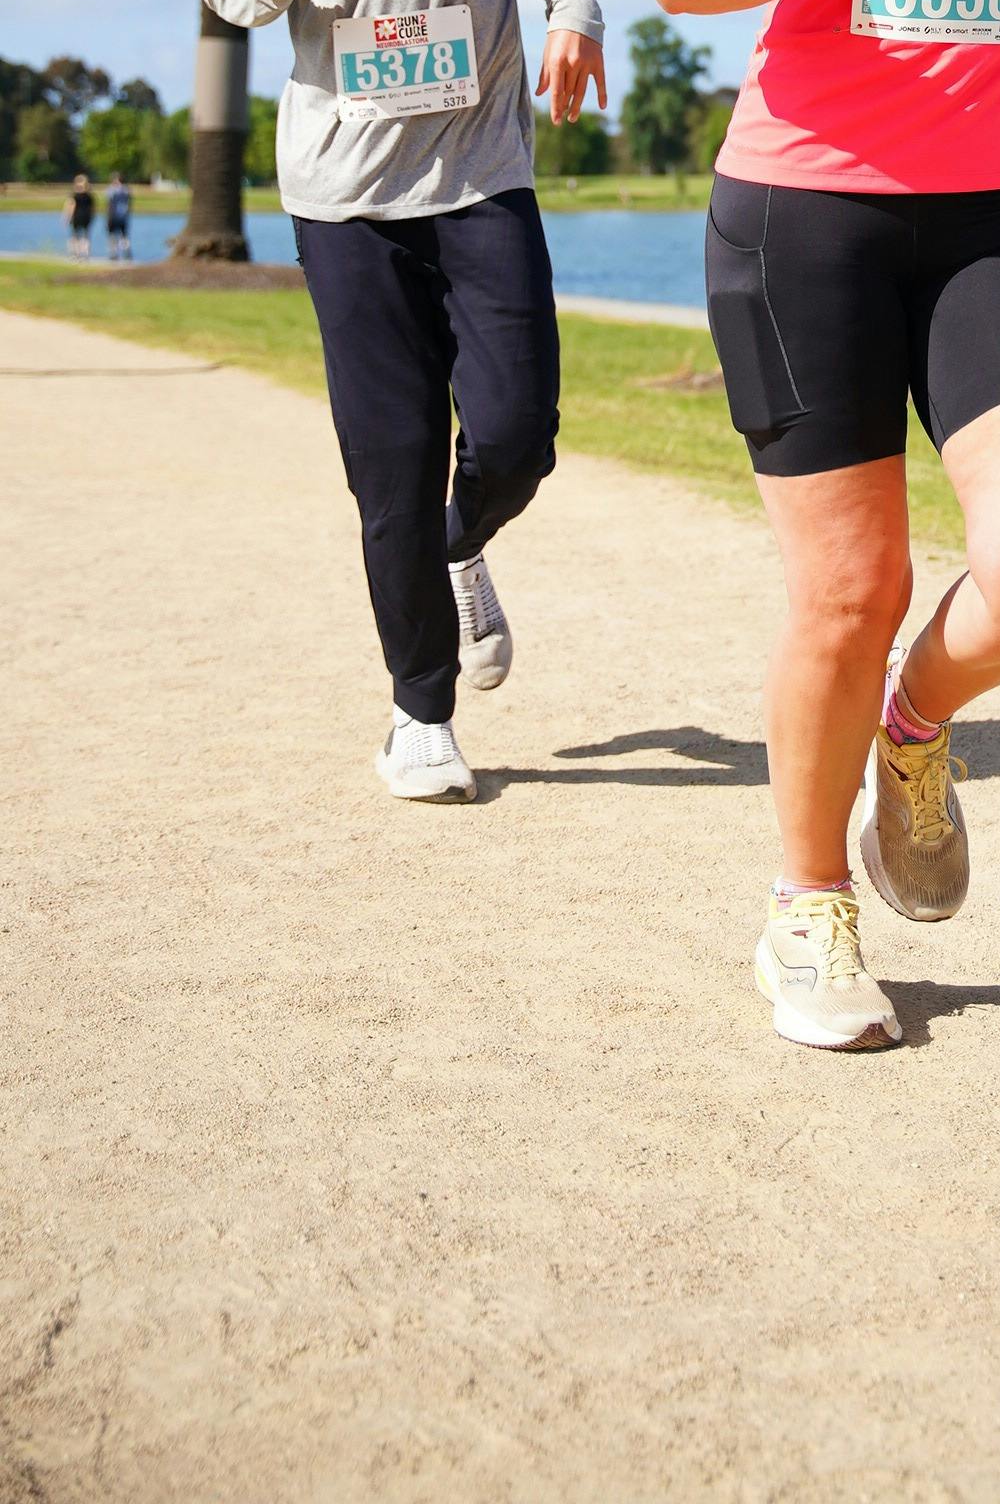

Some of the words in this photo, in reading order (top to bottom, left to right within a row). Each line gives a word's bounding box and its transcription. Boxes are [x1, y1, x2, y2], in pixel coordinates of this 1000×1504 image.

[399, 25, 428, 38] CURE
[376, 37, 429, 48] NEUROBLASTOMA
[355, 42, 456, 91] 5378
[443, 95, 467, 108] 5378
